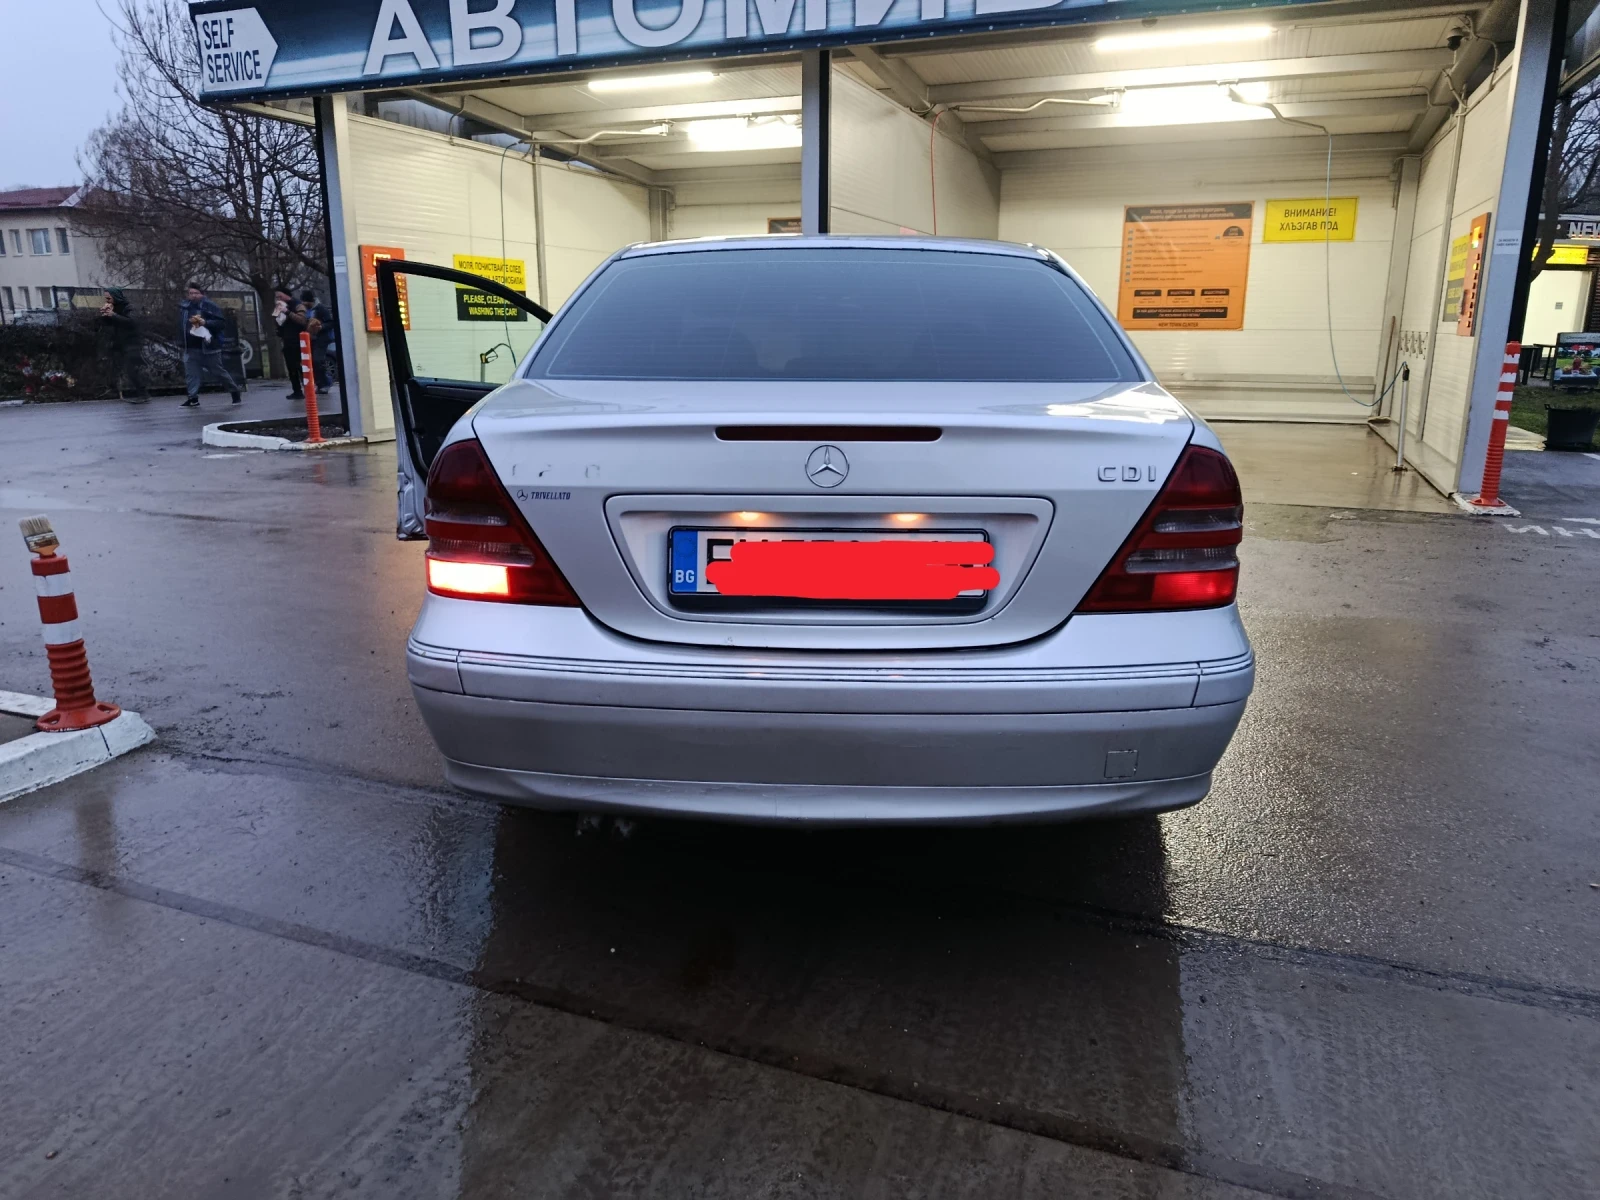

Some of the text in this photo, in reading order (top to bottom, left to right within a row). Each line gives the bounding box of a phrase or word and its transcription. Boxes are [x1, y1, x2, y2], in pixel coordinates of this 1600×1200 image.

[203, 17, 234, 50] SELF
[206, 50, 262, 84] SERVICE
[1284, 208, 1337, 218] ВНИМАНИЕ!
[1280, 221, 1339, 231] ХЛЪЗГАВ ПОД
[463, 294, 504, 305] PLEASE, CLEAN
[468, 306, 494, 315] WASHING
[494, 307, 504, 316] THE
[1097, 464, 1156, 482] CDI
[531, 491, 571, 500] TRIVELLATO
[675, 570, 695, 583] BG
